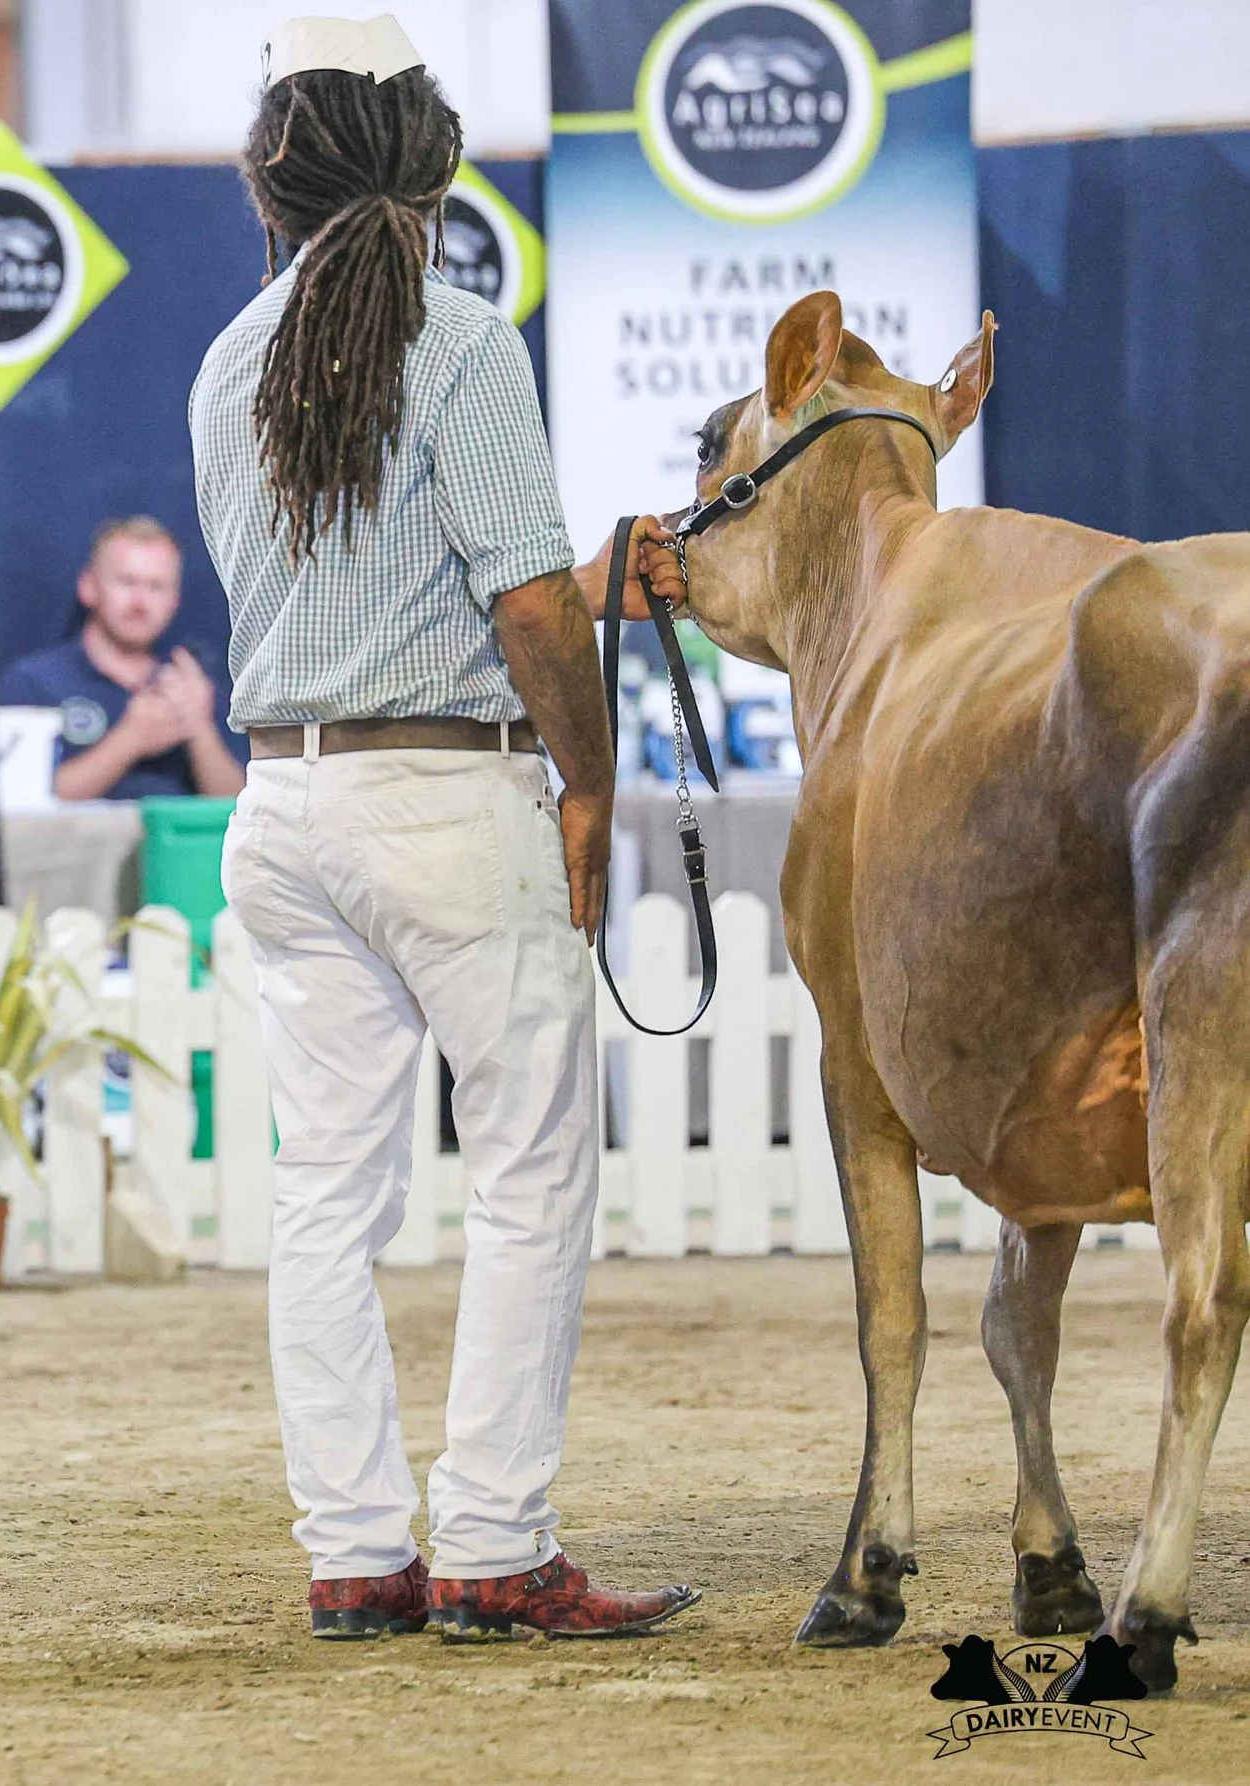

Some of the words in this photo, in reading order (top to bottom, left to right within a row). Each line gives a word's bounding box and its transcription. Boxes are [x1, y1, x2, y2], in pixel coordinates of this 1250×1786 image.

[672, 85, 845, 133] AgriSea
[689, 255, 838, 295] FARM
[618, 303, 909, 348] NUTRION
